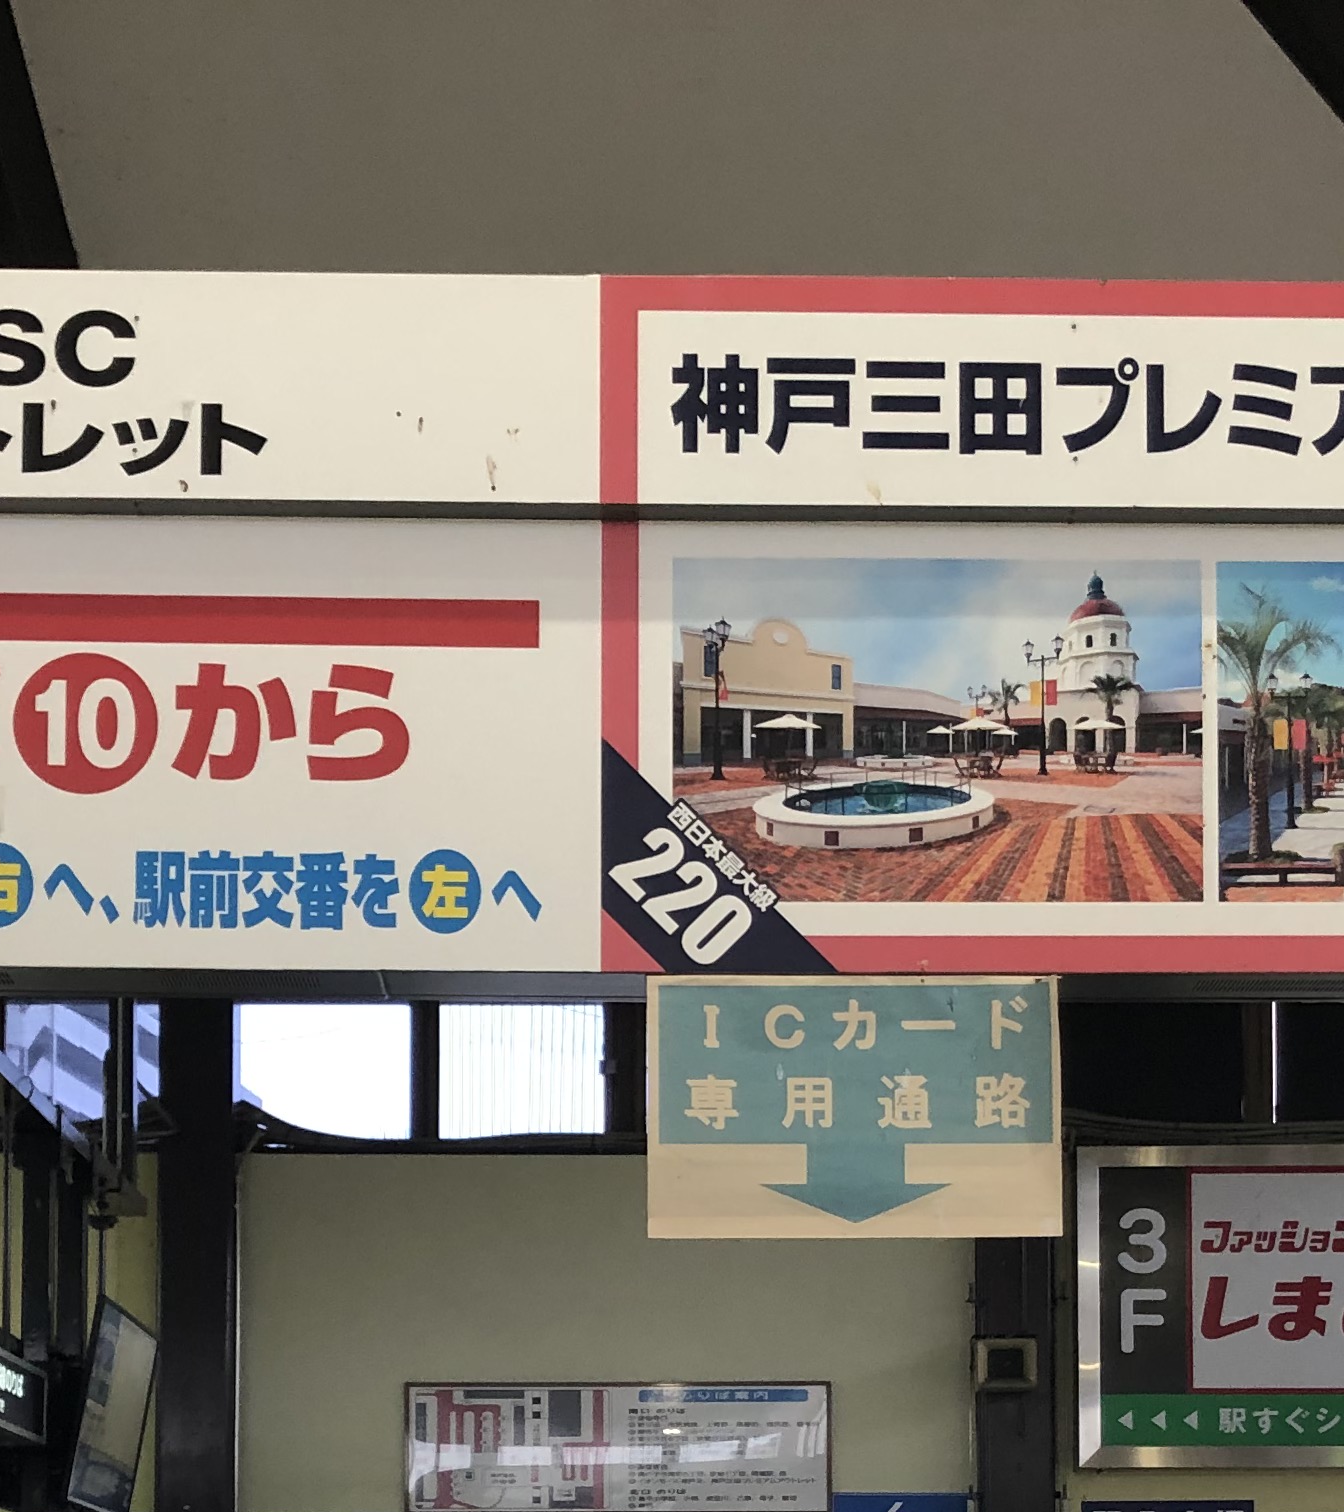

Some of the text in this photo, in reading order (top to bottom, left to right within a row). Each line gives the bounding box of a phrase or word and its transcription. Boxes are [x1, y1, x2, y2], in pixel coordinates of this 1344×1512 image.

[608, 827, 753, 965] 220
[684, 1073, 1031, 1130] 専用通路
